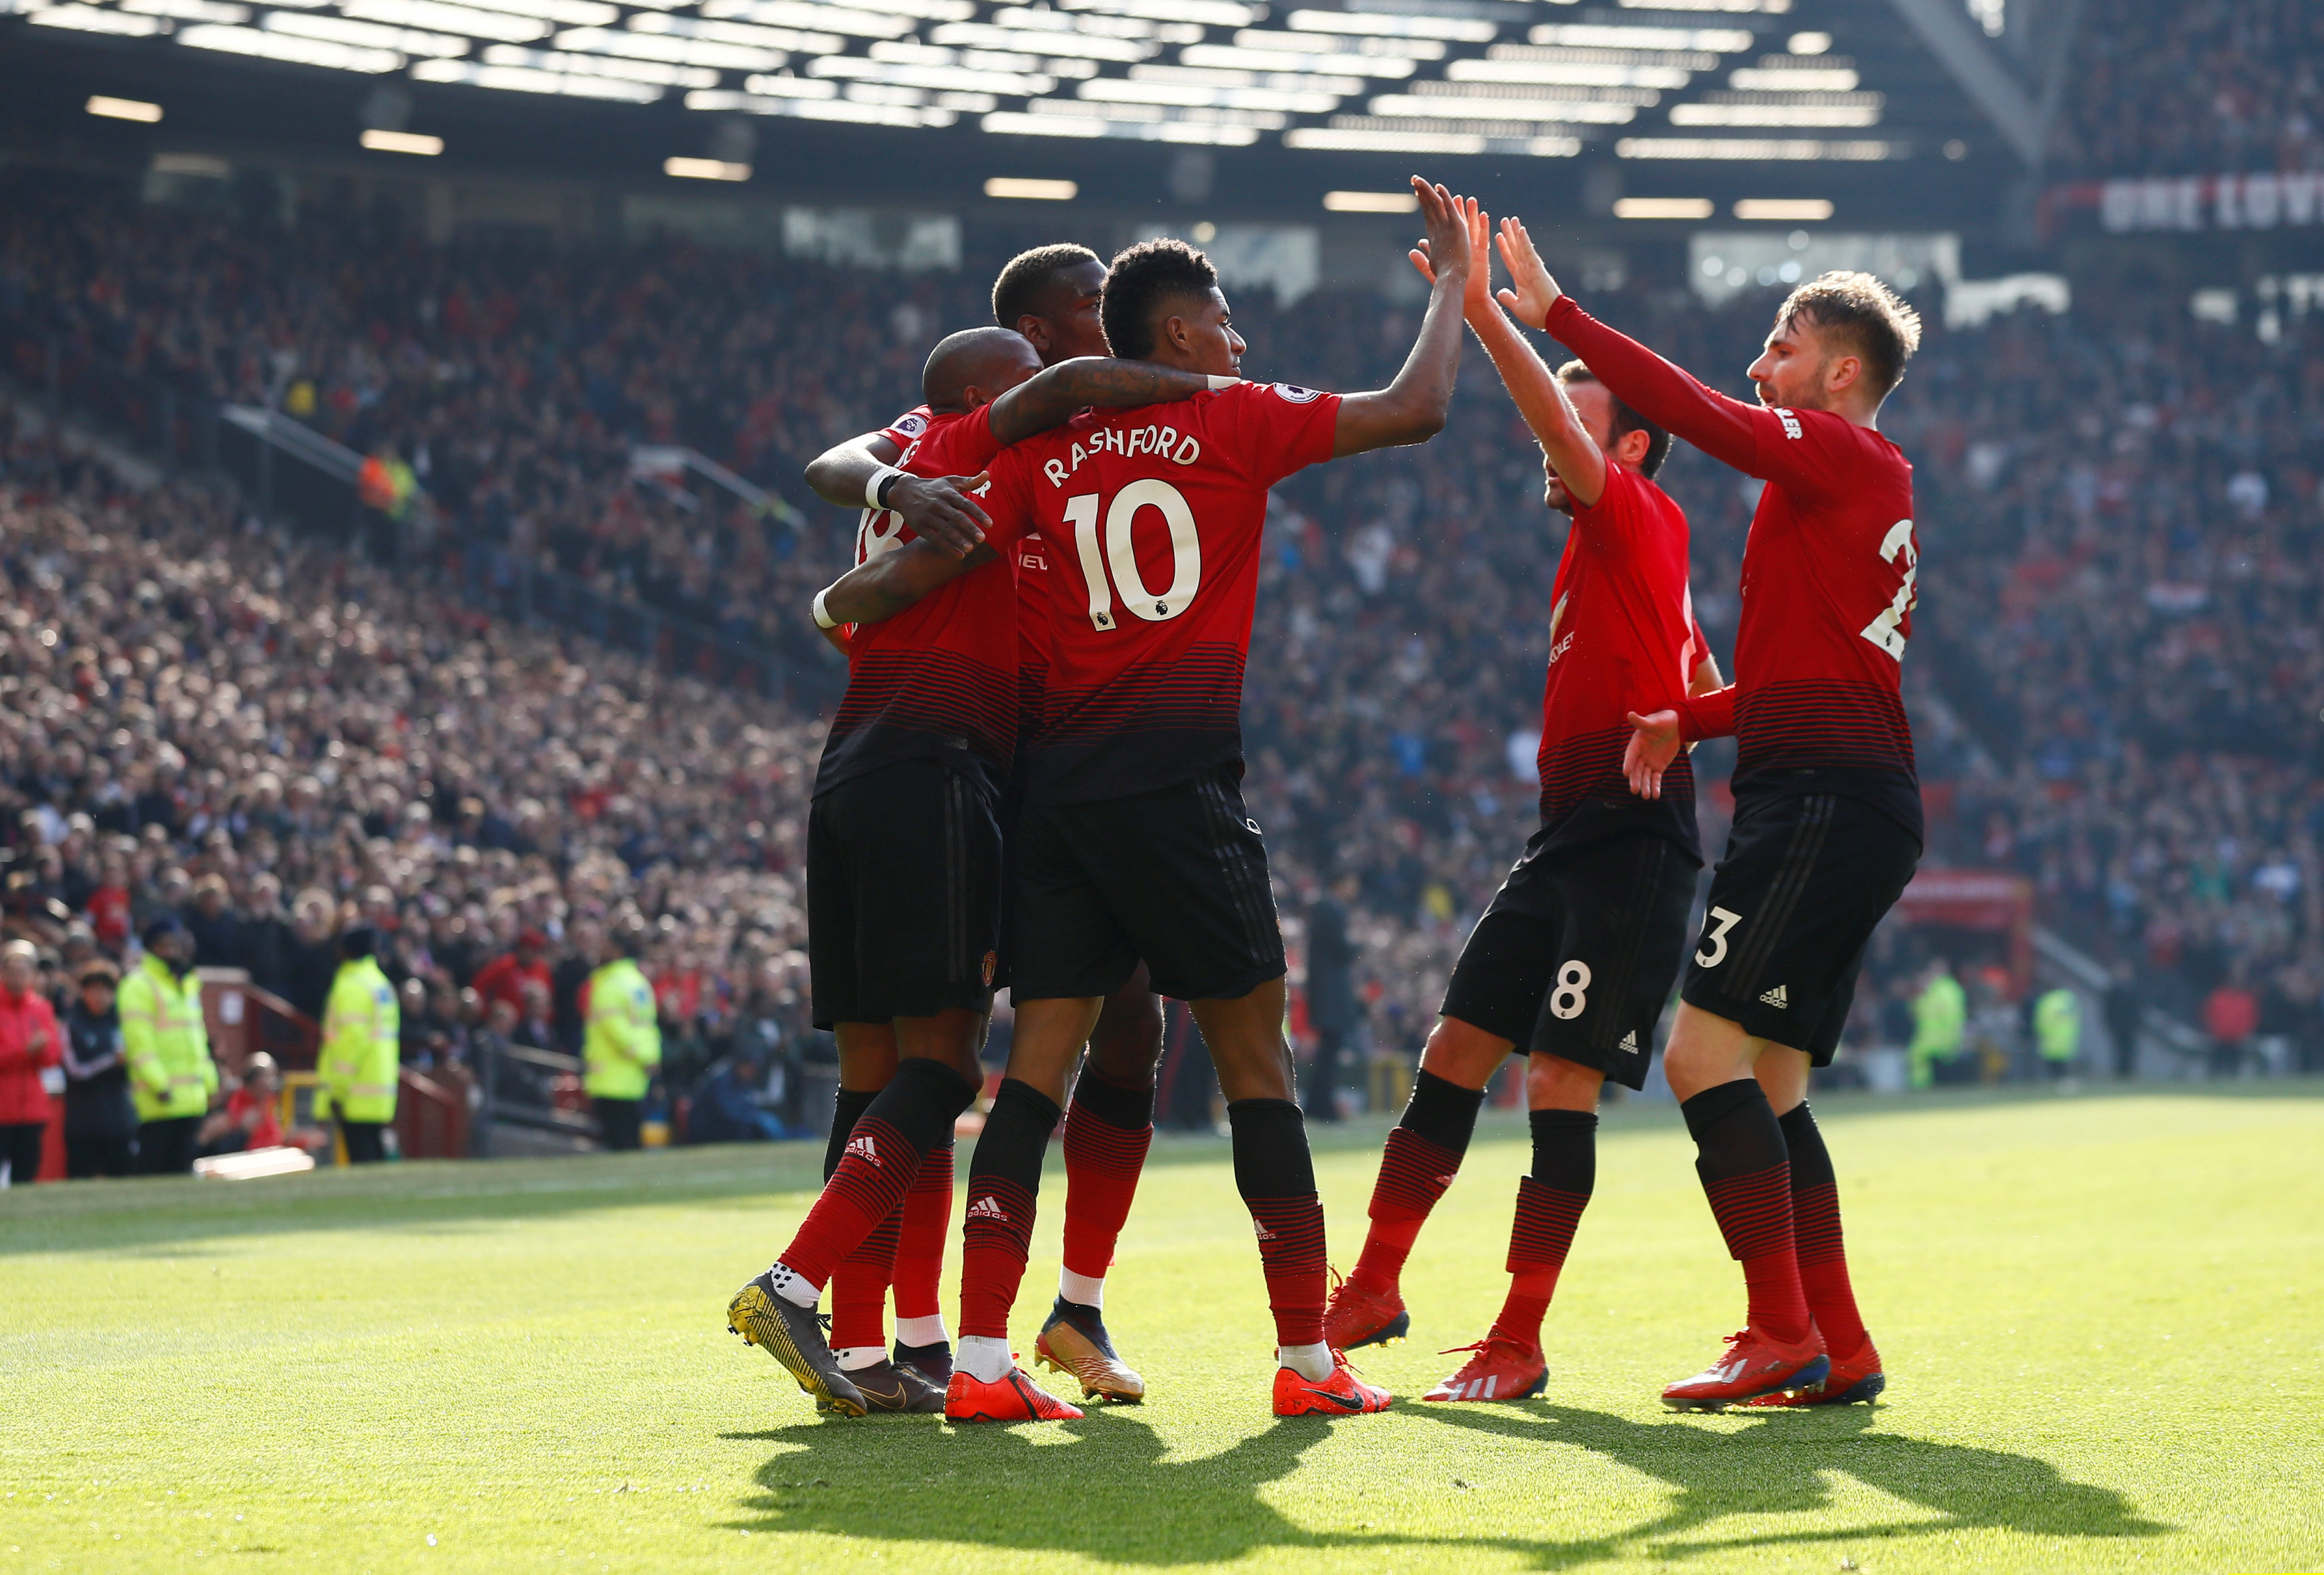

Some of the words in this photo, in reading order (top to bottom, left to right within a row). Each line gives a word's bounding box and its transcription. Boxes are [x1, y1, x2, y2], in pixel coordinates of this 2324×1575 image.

[1043, 424, 1201, 489] RASHFORD
[1062, 478, 1201, 632] 10
[1550, 959, 1592, 1020] 8
[1760, 995, 1787, 1009] adidas
[1619, 1042, 1639, 1054] adidas
[845, 1146, 882, 1167] adidas
[967, 1209, 1008, 1222] adidas
